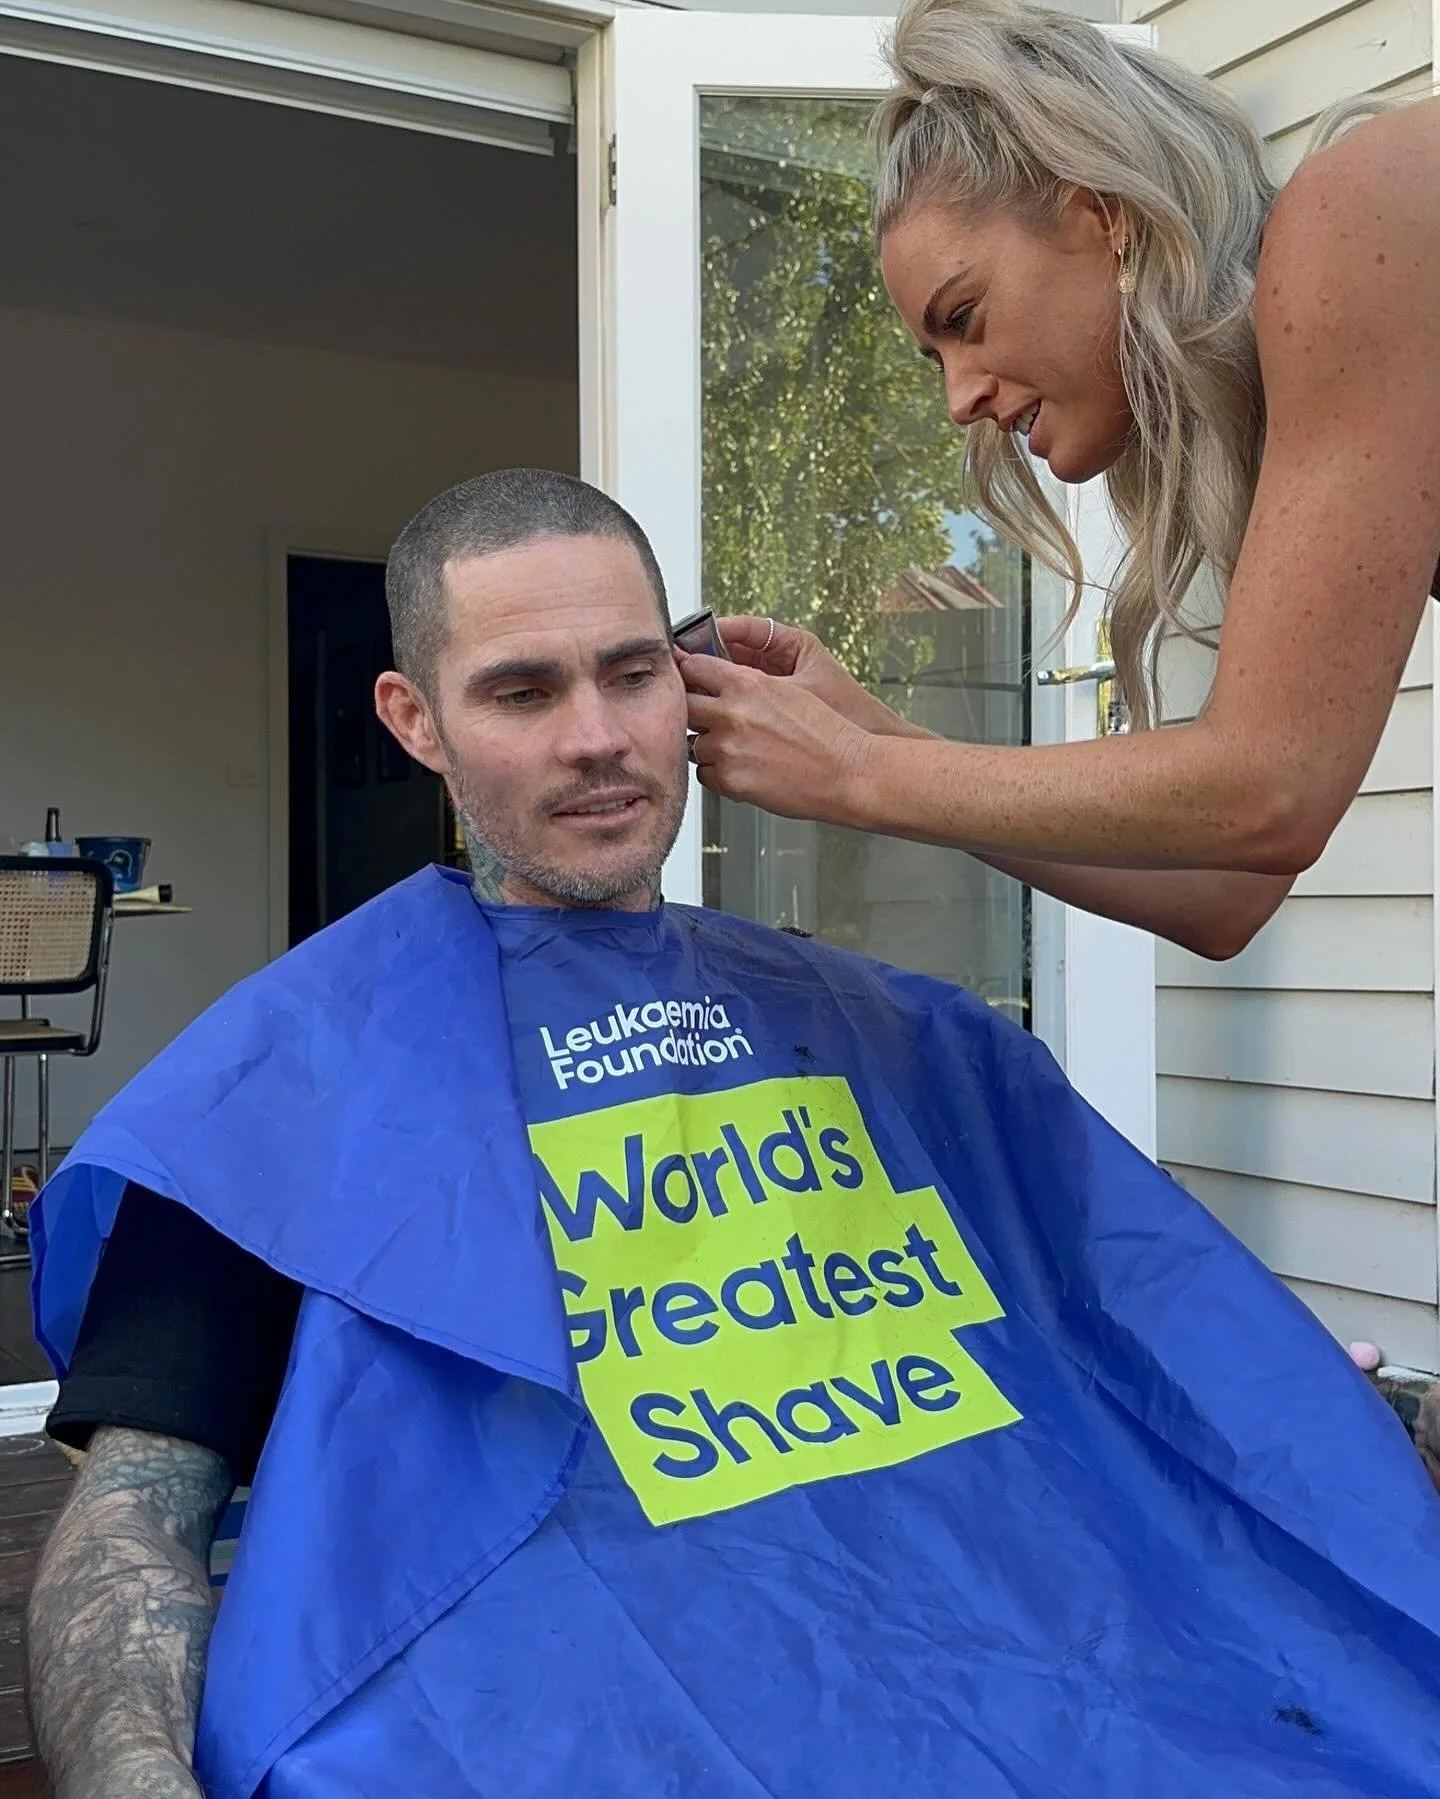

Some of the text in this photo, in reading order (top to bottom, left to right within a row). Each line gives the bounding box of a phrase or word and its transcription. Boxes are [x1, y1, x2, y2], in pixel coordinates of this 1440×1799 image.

[540, 995, 731, 1058] Leukaemia
[550, 1029, 754, 1090] Foundation
[534, 1106, 863, 1242] World's
[557, 1223, 962, 1363] Greatest
[630, 1354, 961, 1479] Shave
